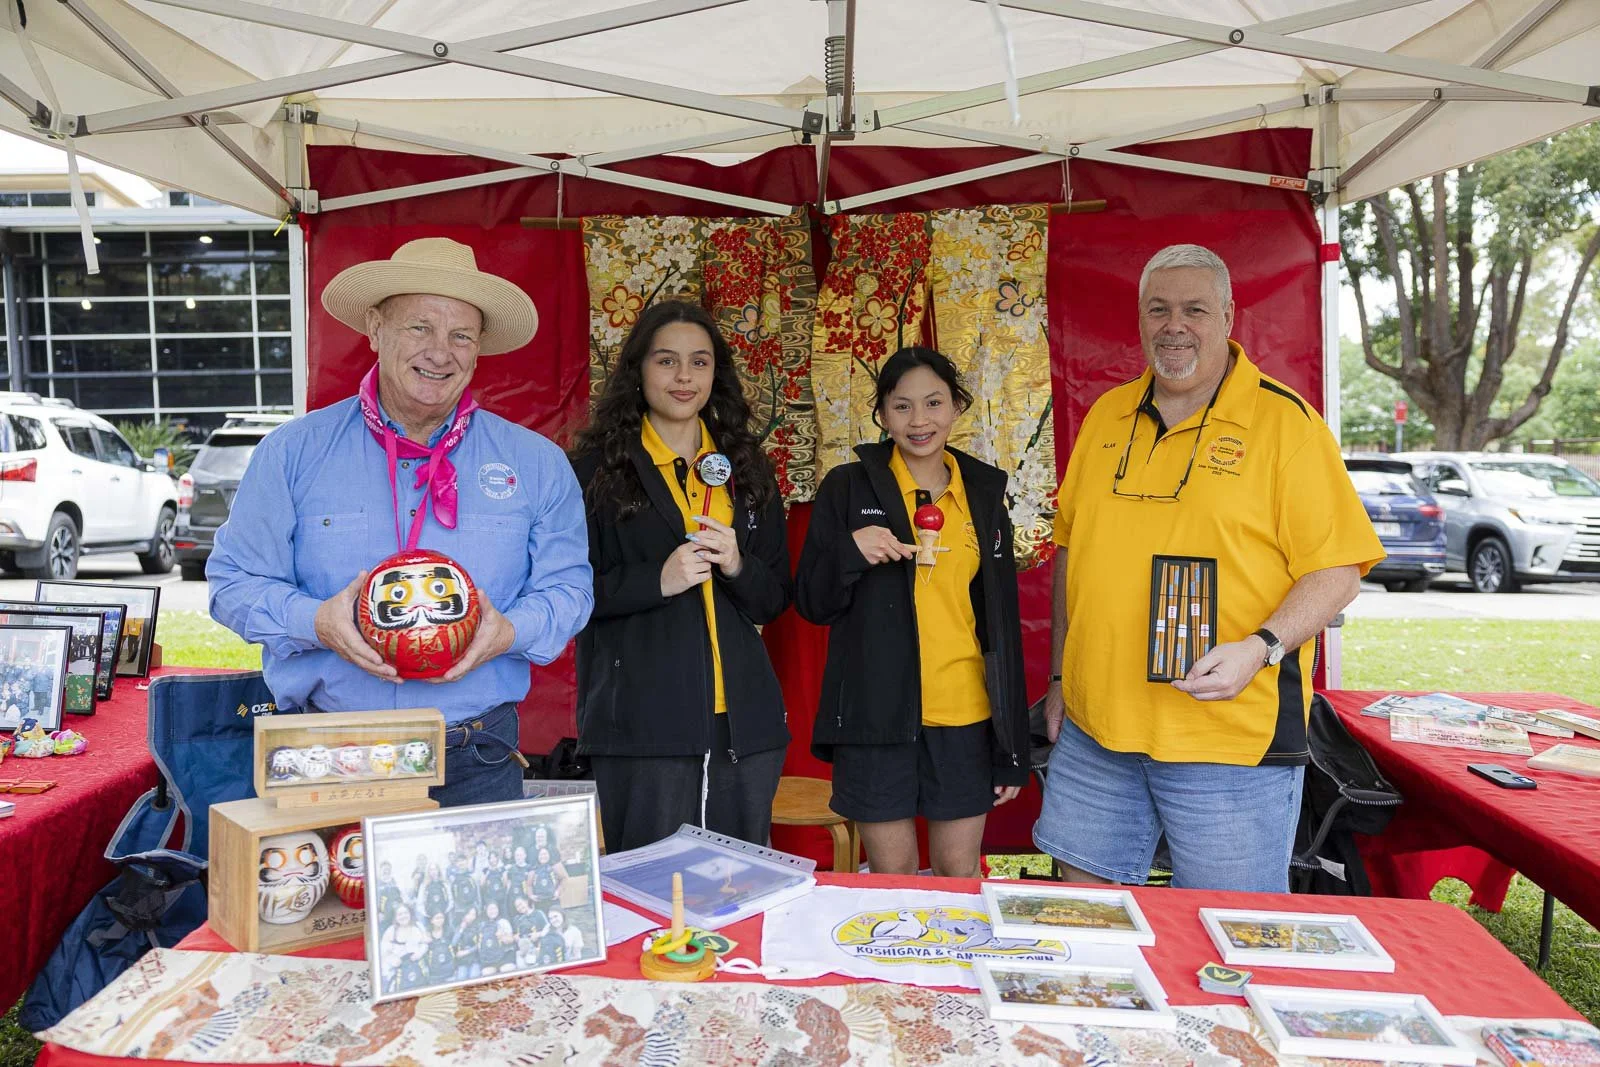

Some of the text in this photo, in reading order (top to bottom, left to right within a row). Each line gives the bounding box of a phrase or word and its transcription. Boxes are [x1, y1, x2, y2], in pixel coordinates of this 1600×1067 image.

[1271, 177, 1305, 188] LIFT HERE
[251, 702, 277, 714] OZtr
[856, 945, 931, 957] KOSHIGAYA
[935, 948, 944, 957] &
